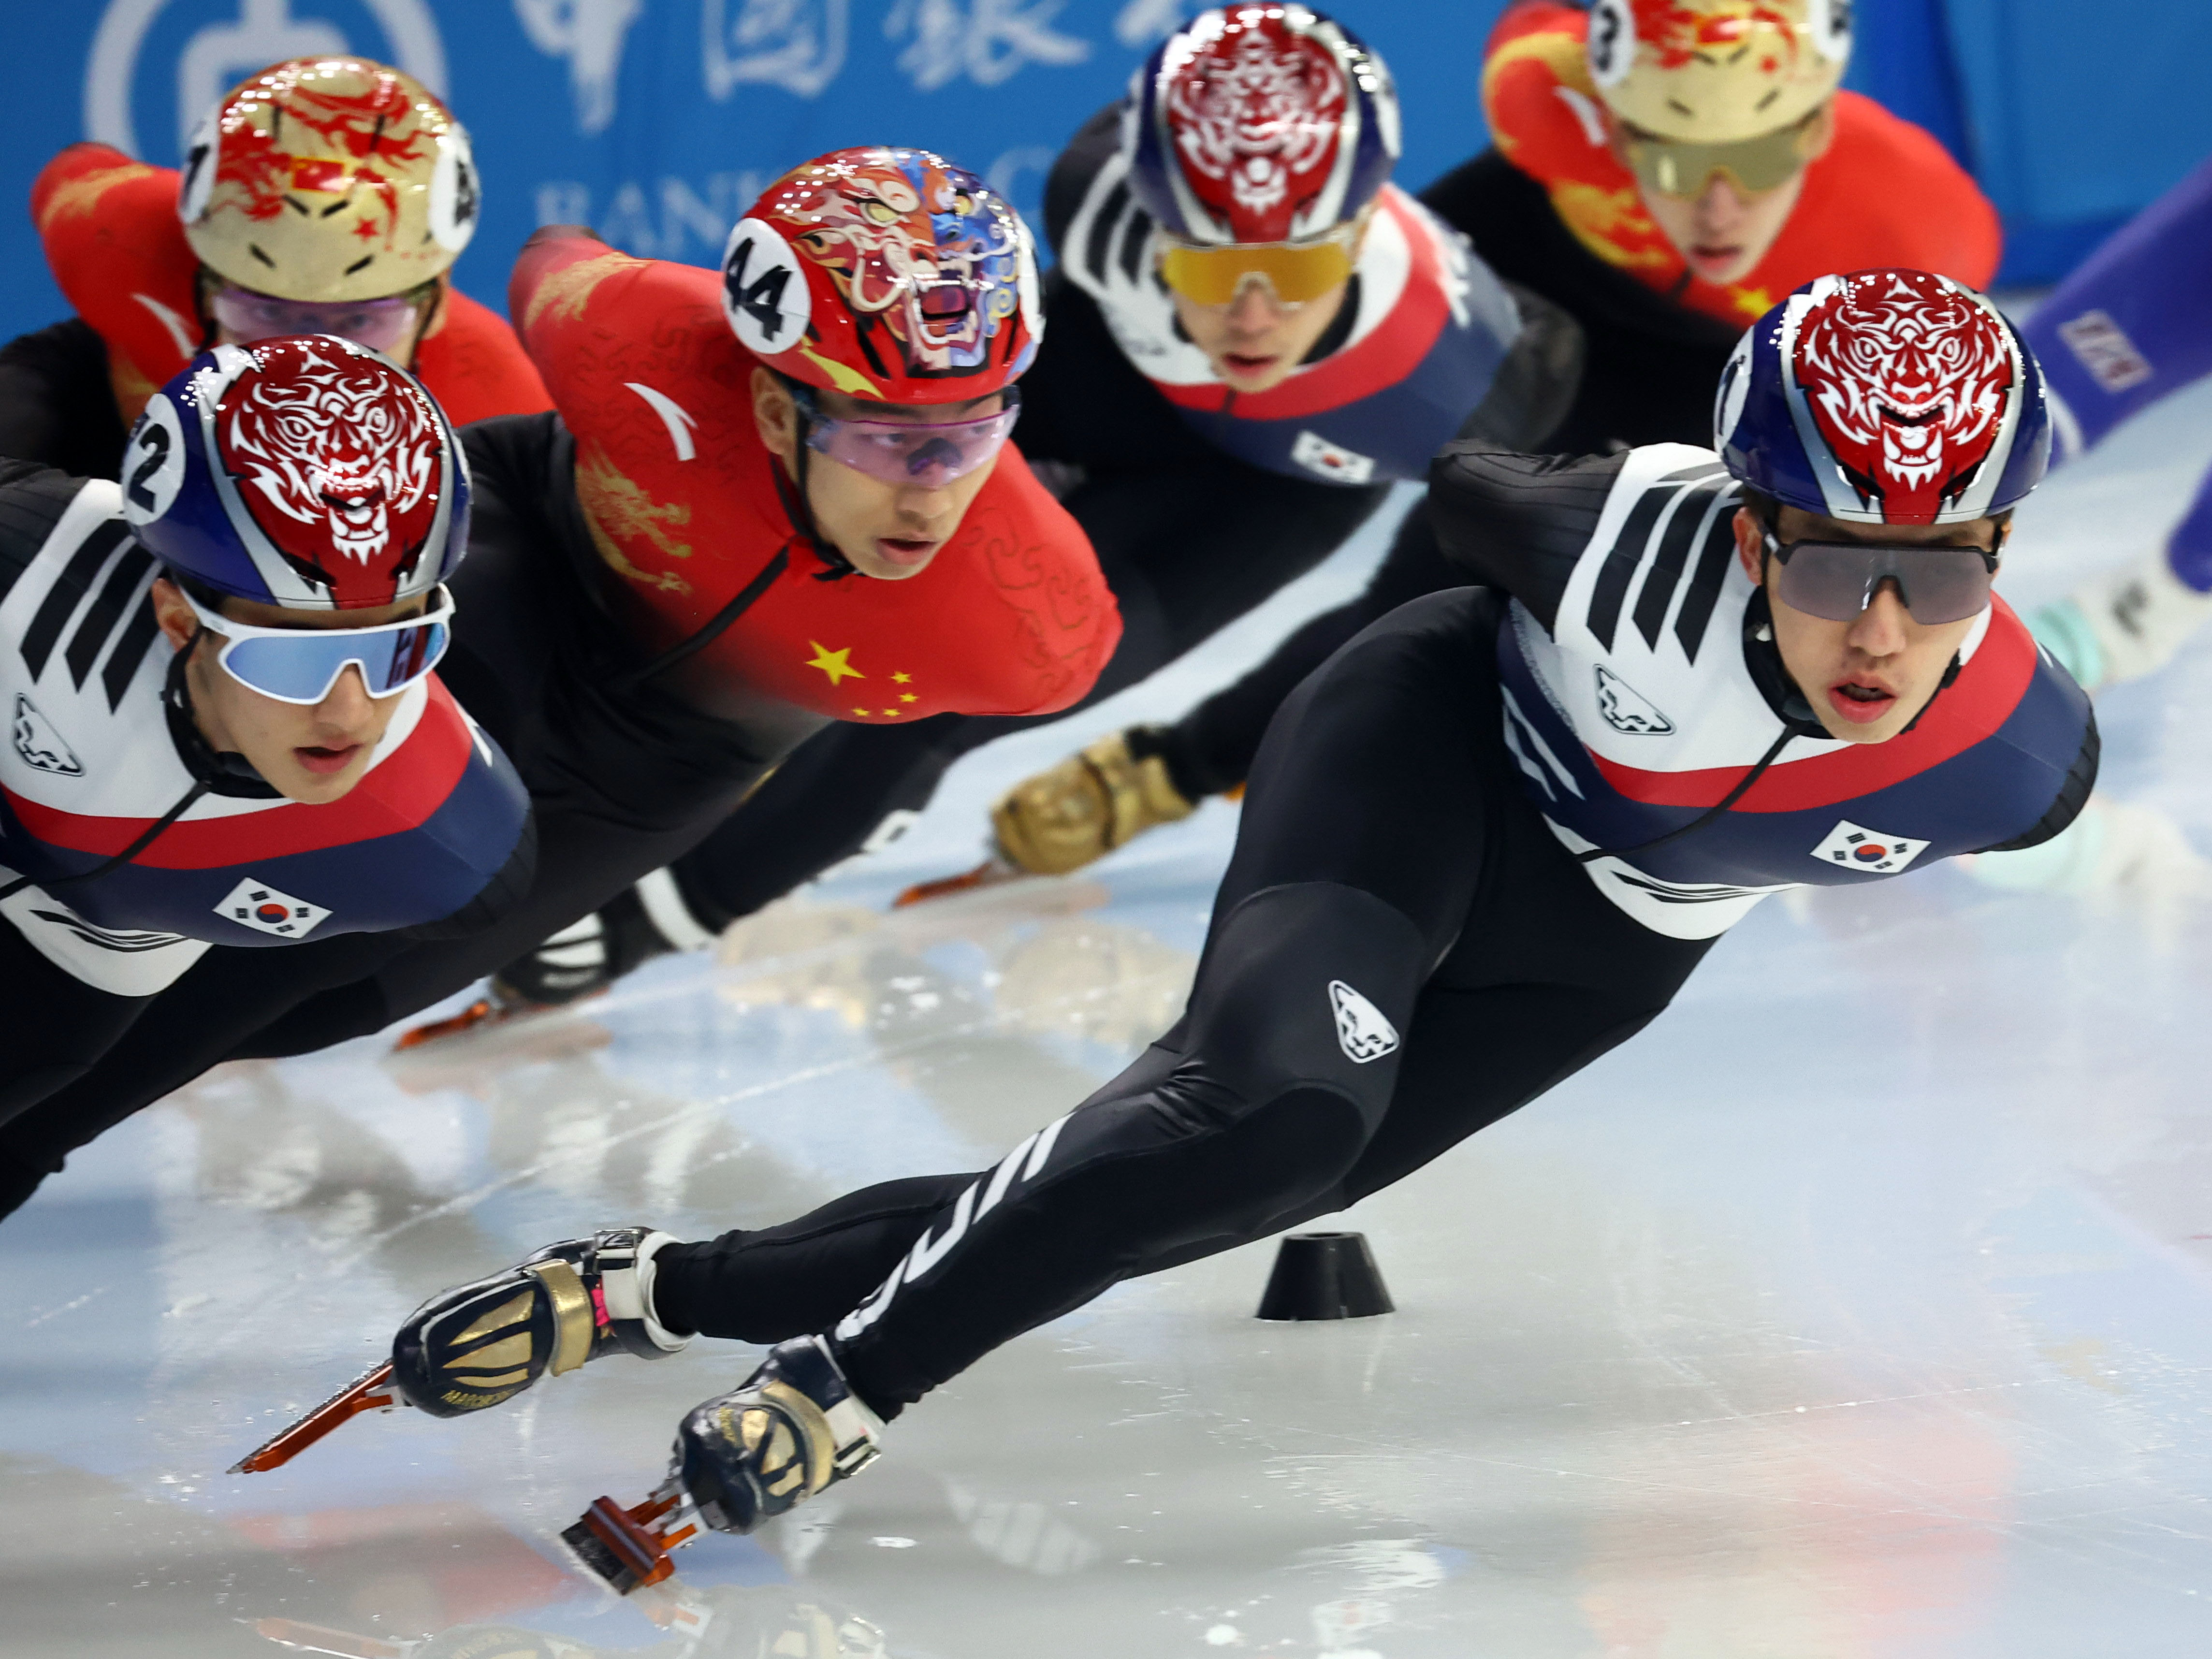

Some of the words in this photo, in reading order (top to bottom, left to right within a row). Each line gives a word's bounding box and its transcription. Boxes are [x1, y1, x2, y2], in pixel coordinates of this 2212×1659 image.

[536, 172, 761, 256] BAN
[726, 236, 793, 342] 44
[128, 423, 170, 513] 2
